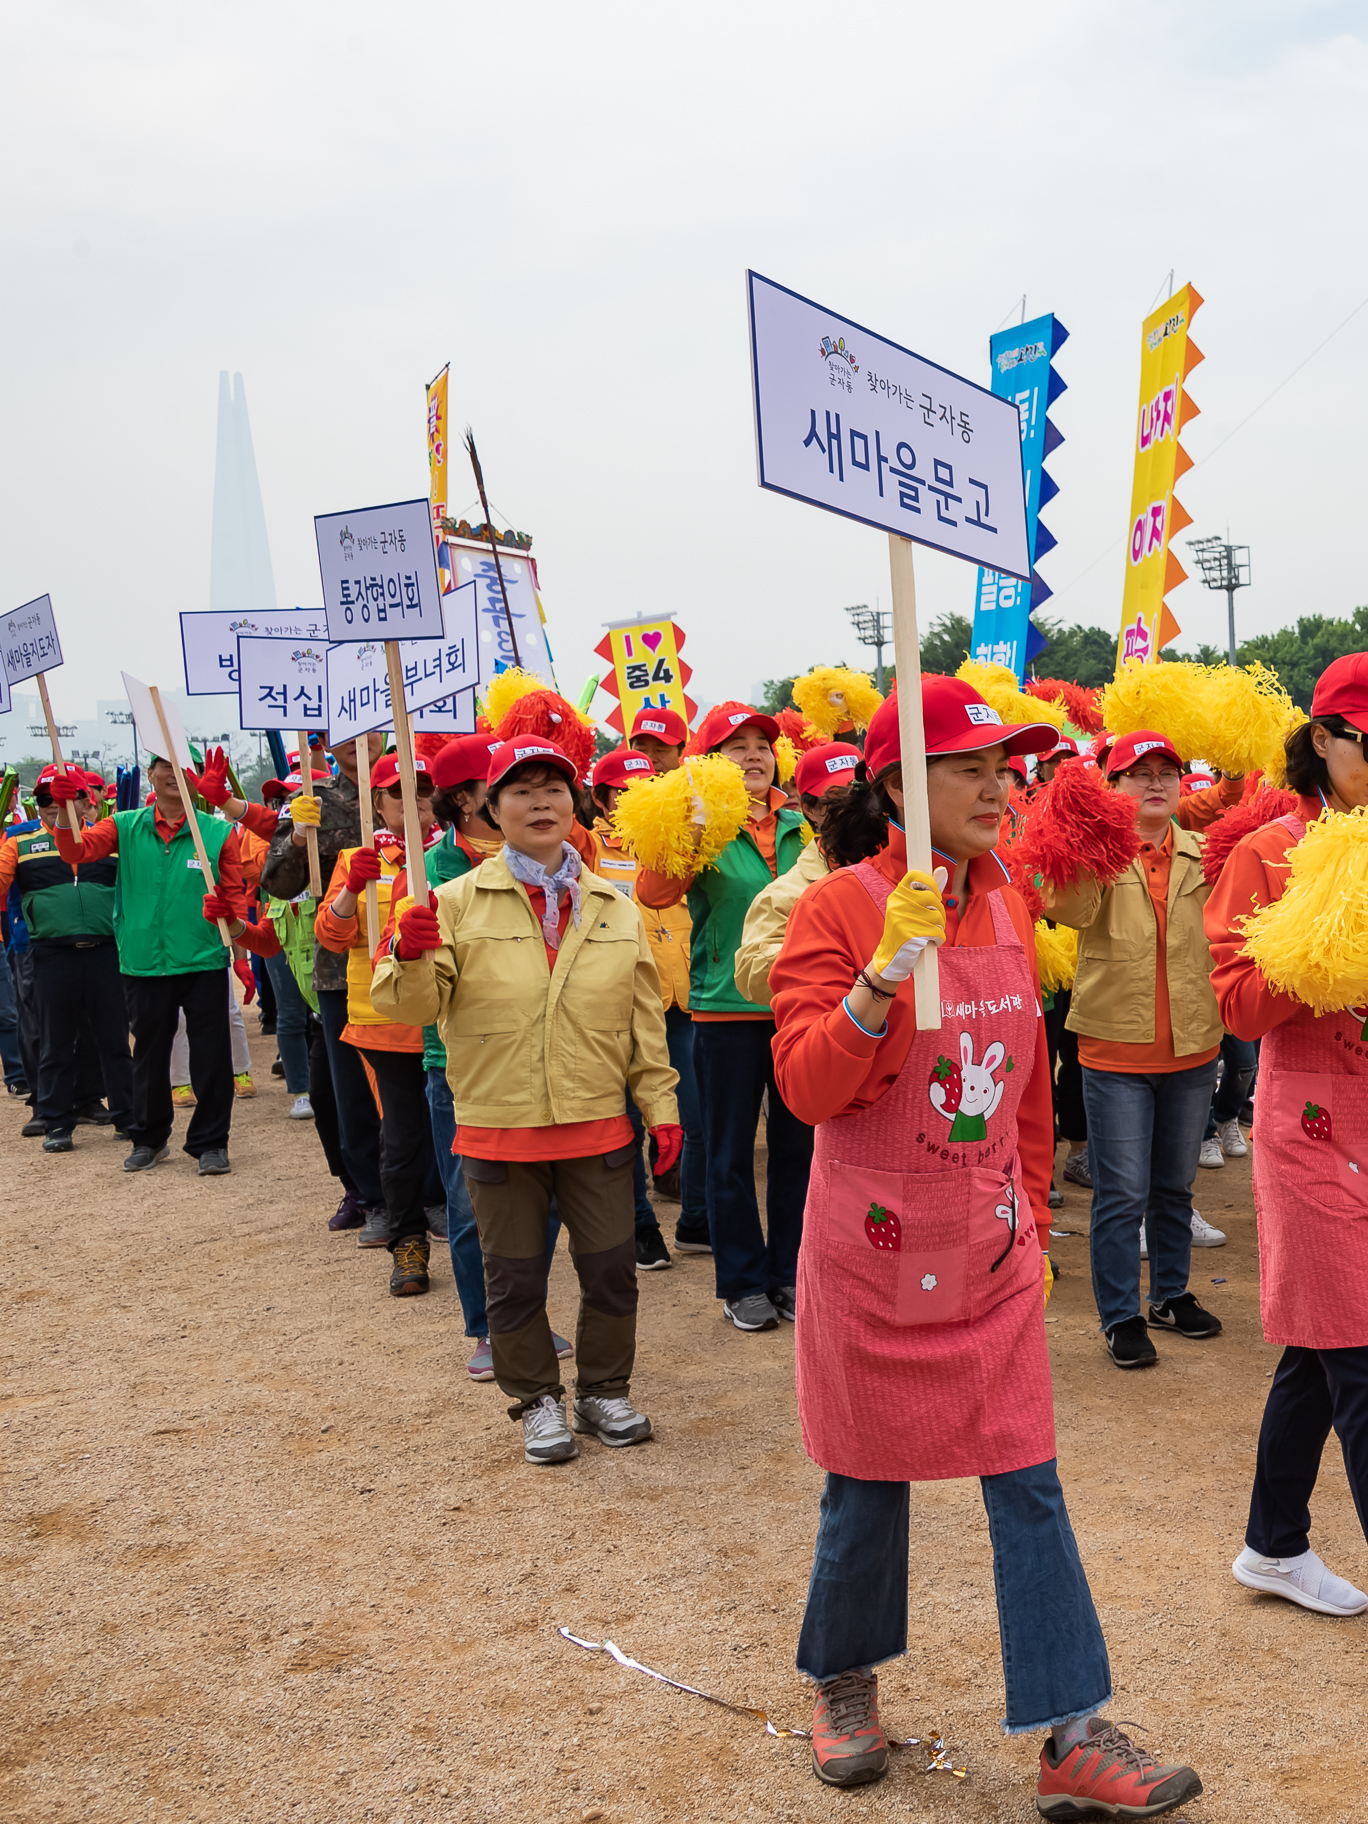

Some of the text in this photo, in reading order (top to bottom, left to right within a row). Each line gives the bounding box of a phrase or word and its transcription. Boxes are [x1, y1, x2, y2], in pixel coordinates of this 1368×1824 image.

[867, 370, 974, 444] 찾아가는 군자동
[803, 408, 998, 534] 새마을문고
[380, 528, 406, 554] 군자동
[339, 570, 423, 625] 통장협의회
[7, 630, 56, 672] 새마을지도자
[626, 657, 674, 690] 중4
[642, 721, 665, 732] 군자동
[826, 757, 857, 771] 군자동
[915, 1132, 967, 1167] sweet
